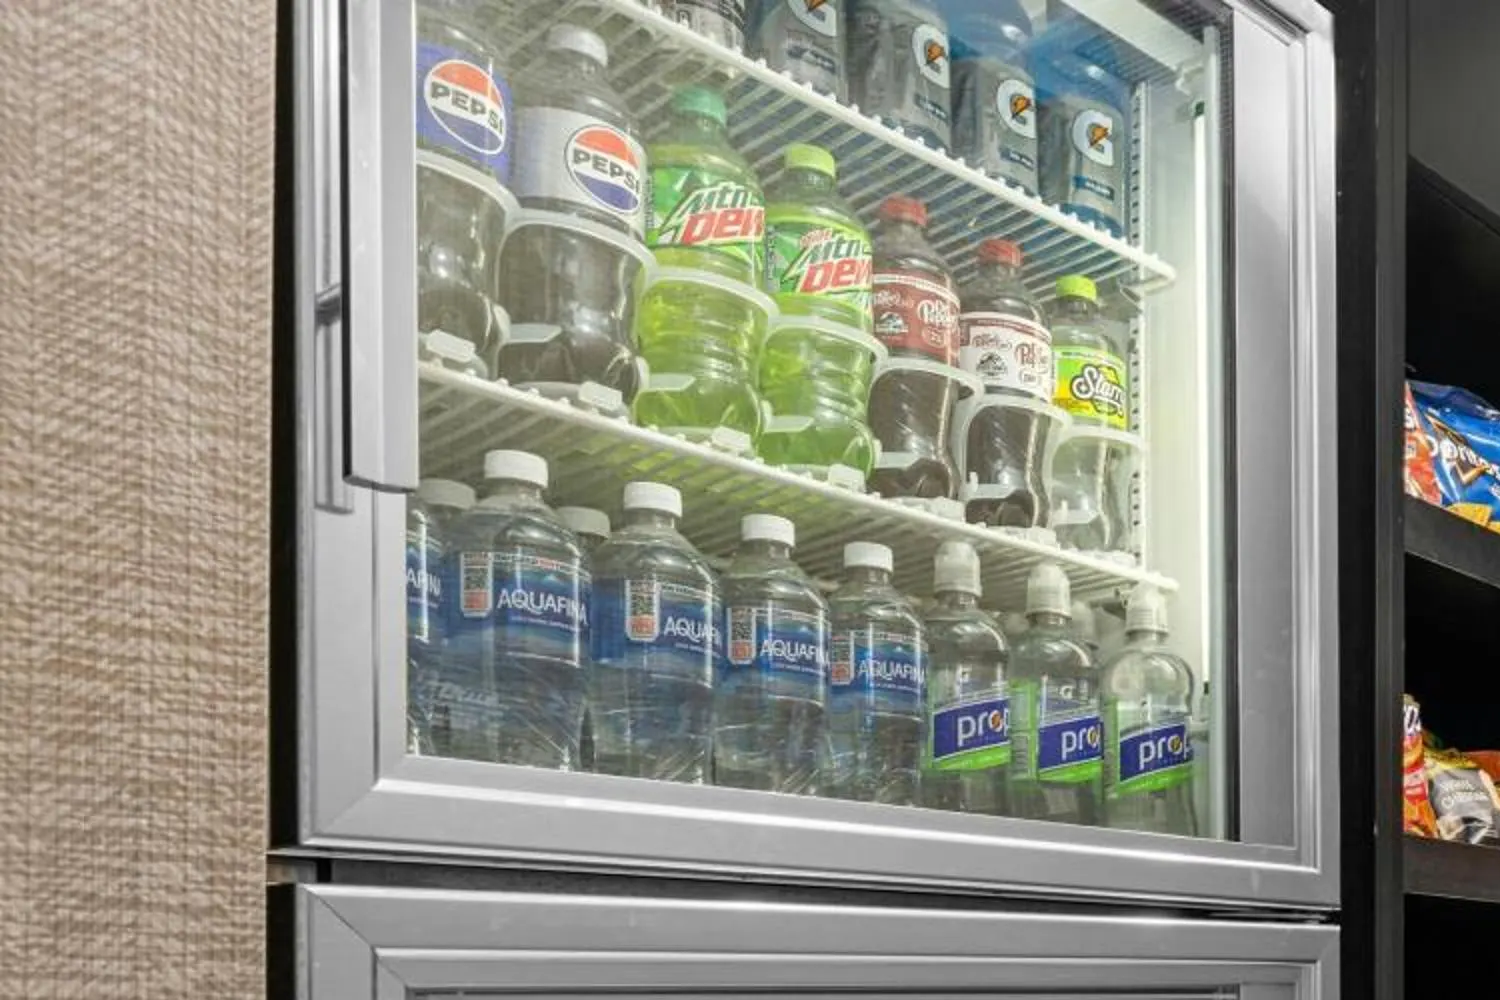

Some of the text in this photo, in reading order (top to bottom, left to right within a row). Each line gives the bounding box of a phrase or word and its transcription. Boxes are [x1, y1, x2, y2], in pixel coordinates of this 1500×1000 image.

[430, 81, 503, 132] PEPSI
[572, 149, 640, 193] PEPSI
[497, 588, 588, 626] AQUAFINA
